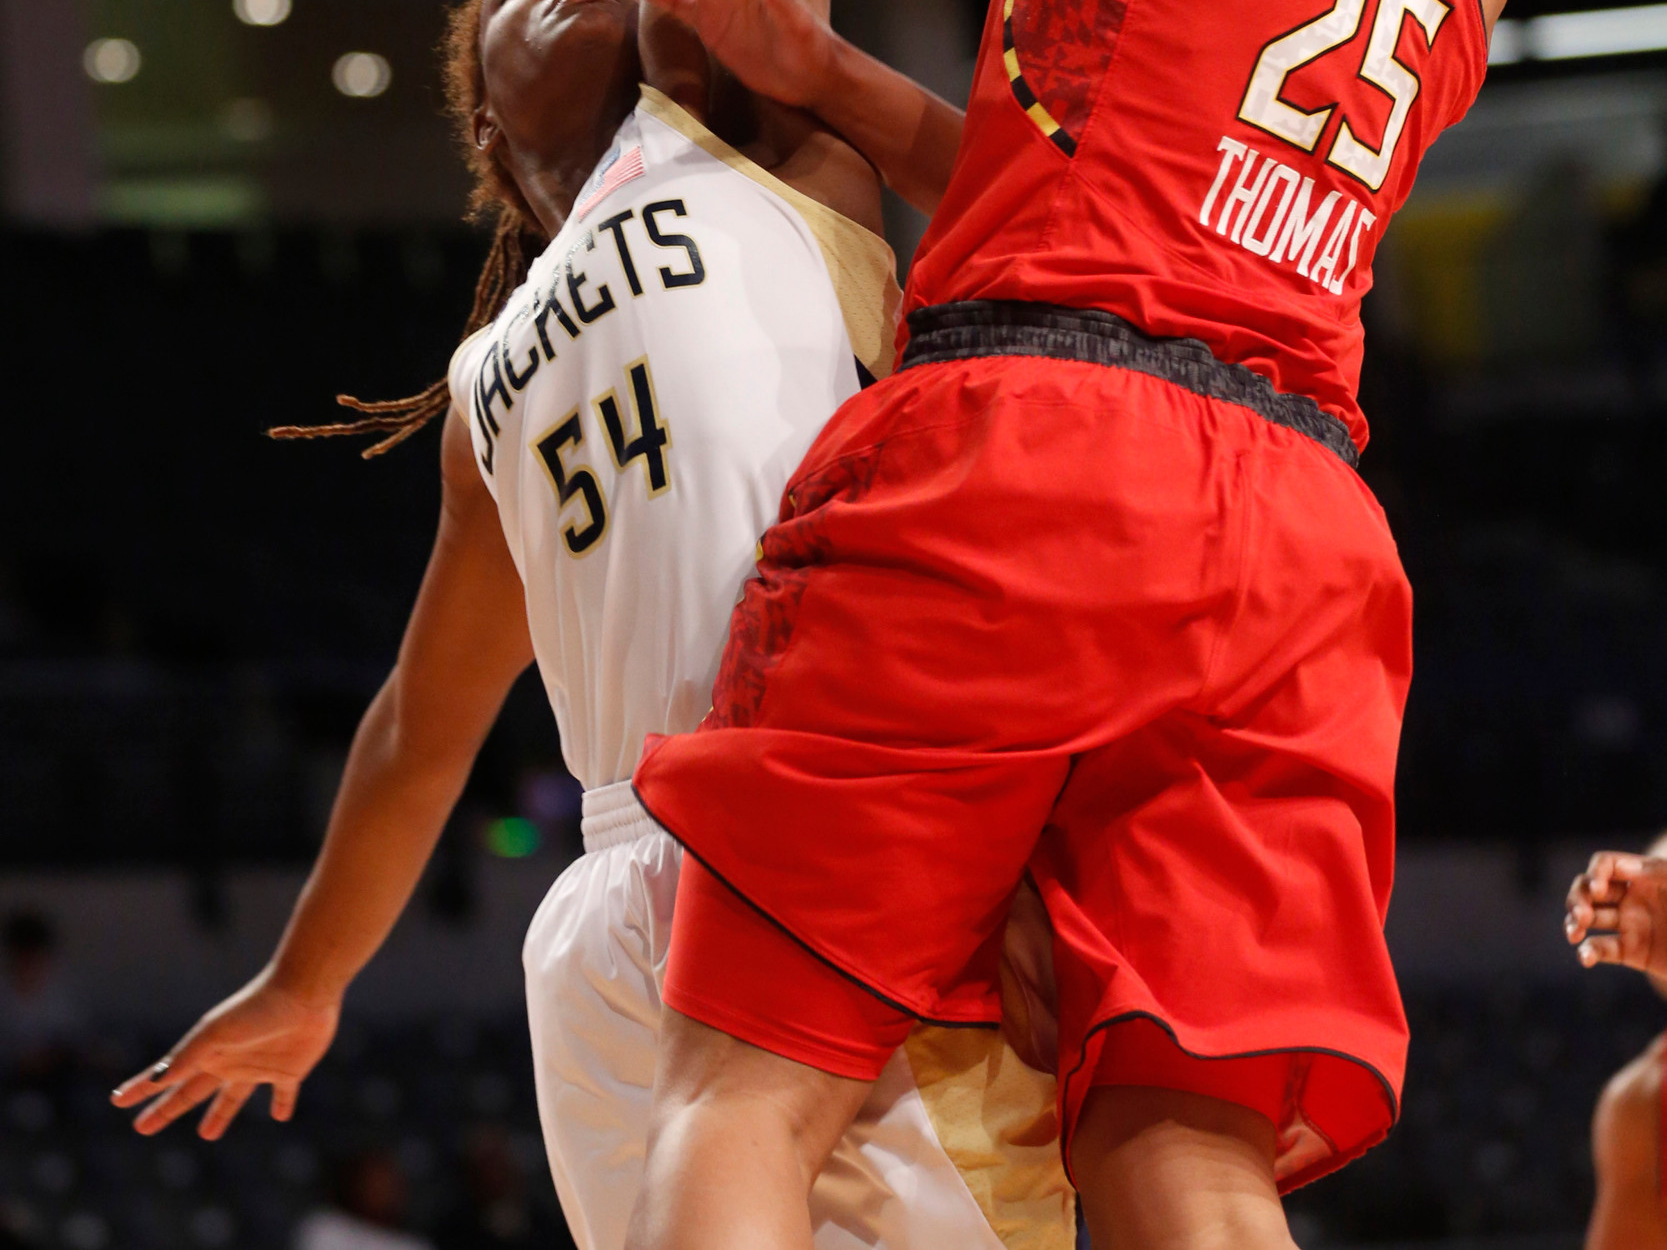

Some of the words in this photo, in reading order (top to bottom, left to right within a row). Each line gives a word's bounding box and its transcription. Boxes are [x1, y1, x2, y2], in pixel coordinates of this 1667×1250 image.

[1199, 136, 1377, 296] THOMAS
[475, 199, 706, 476] JACKETS
[529, 353, 673, 559] 54
